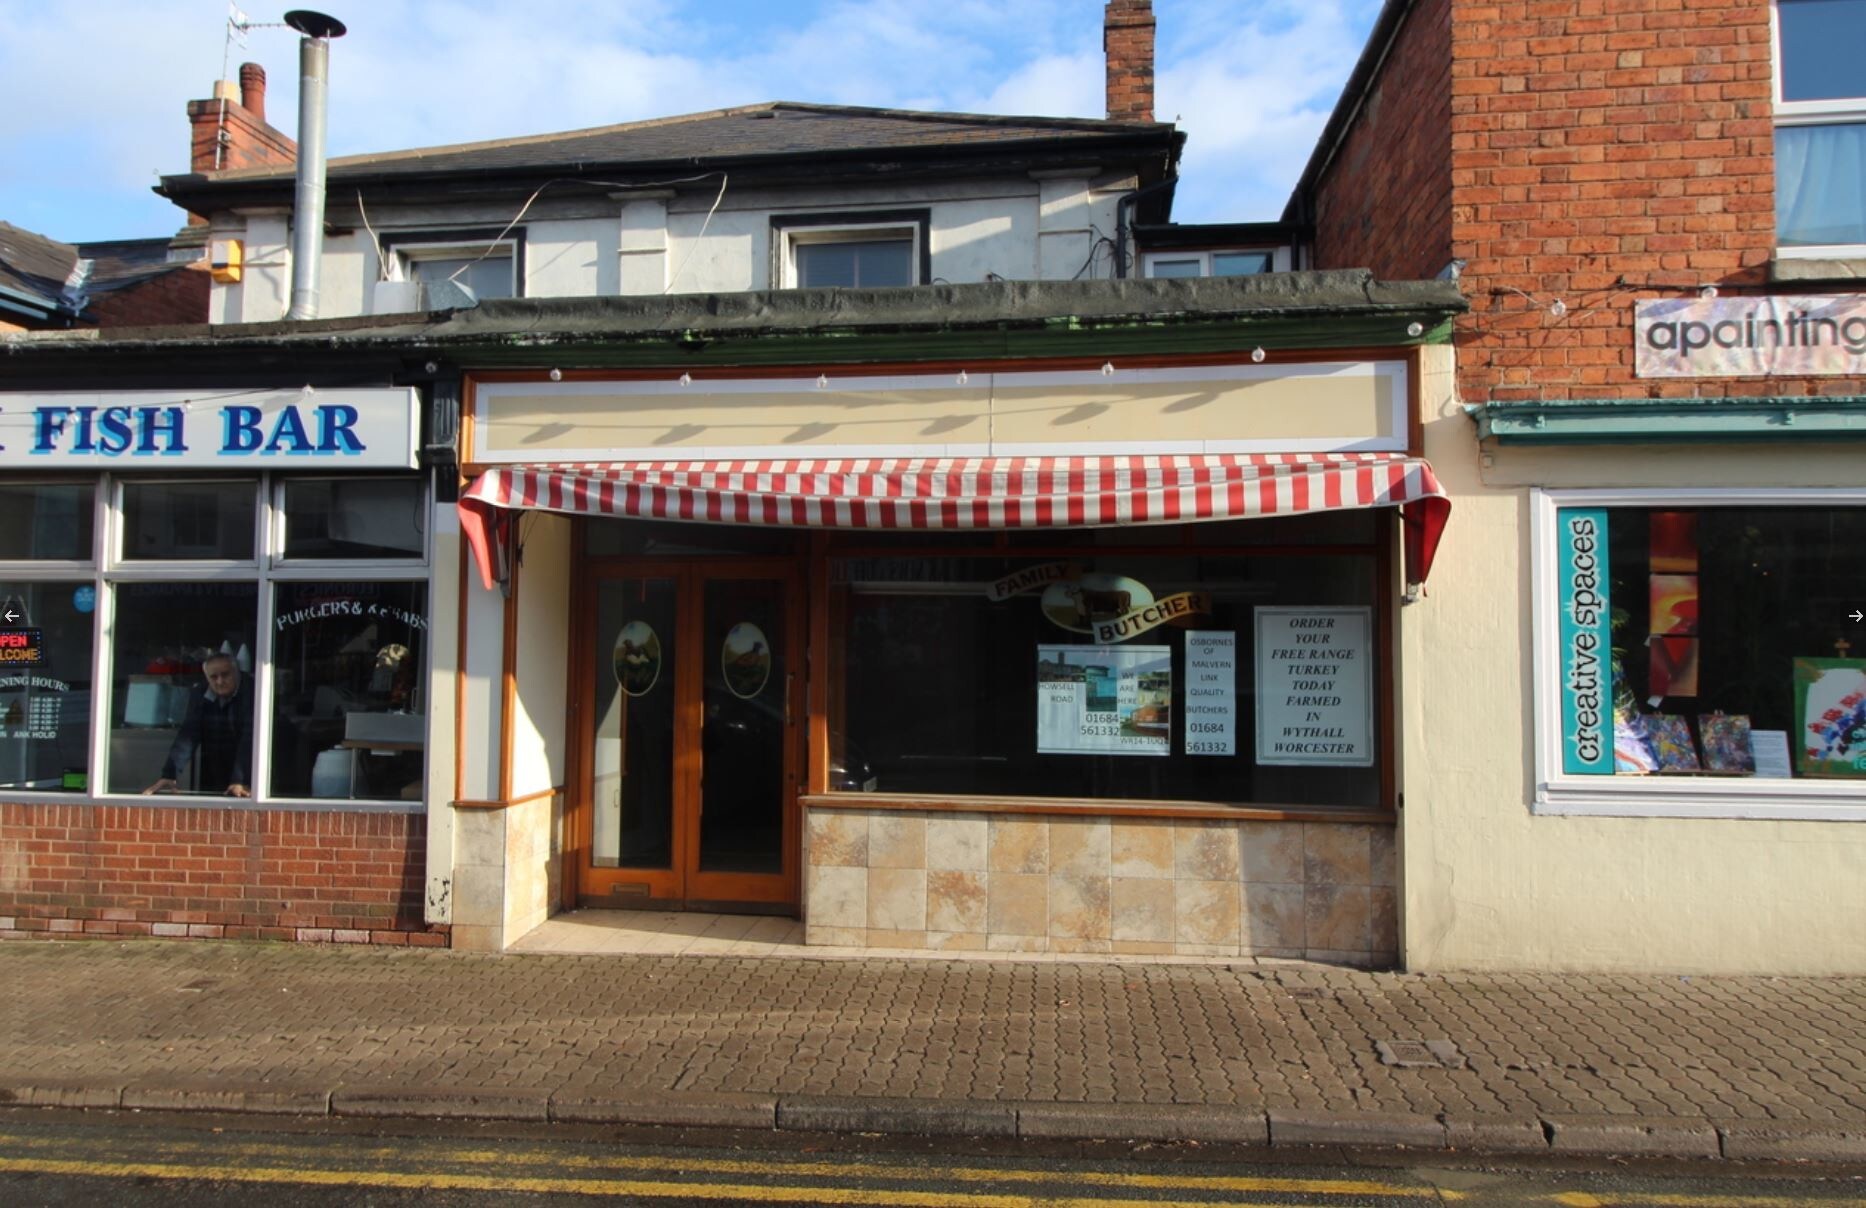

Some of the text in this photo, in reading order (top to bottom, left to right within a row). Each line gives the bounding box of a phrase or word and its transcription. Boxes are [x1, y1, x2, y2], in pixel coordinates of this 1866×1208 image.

[29, 406, 189, 456] FISH
[217, 405, 366, 456] BAR
[995, 564, 1069, 598] FAMILY
[1100, 595, 1202, 642] BUTCHER
[1290, 618, 1335, 628] ORDER
[0, 635, 27, 647] PEN
[1190, 638, 1233, 646] OSBORNES
[1295, 634, 1330, 644] YOUR
[1571, 519, 1601, 763] creative spaces
[1272, 649, 1355, 660] FREE RANGE
[1192, 661, 1231, 669] MALVERN
[1288, 665, 1340, 675] TURKEY
[31, 676, 70, 692] HOURS
[1292, 680, 1335, 690] TODAY
[1190, 688, 1225, 696] QUALITY
[1051, 695, 1074, 703] ROAD
[1286, 696, 1341, 706] FARMED
[1186, 706, 1228, 714] BUTCHERS
[1086, 713, 1119, 723] 01684
[1305, 711, 1321, 722] IN
[1081, 726, 1119, 735] 561332
[1190, 723, 1224, 733] 01684
[1283, 728, 1345, 738] WYTHALL
[1186, 742, 1227, 752] 561332
[1274, 743, 1354, 753] WORCESTER
